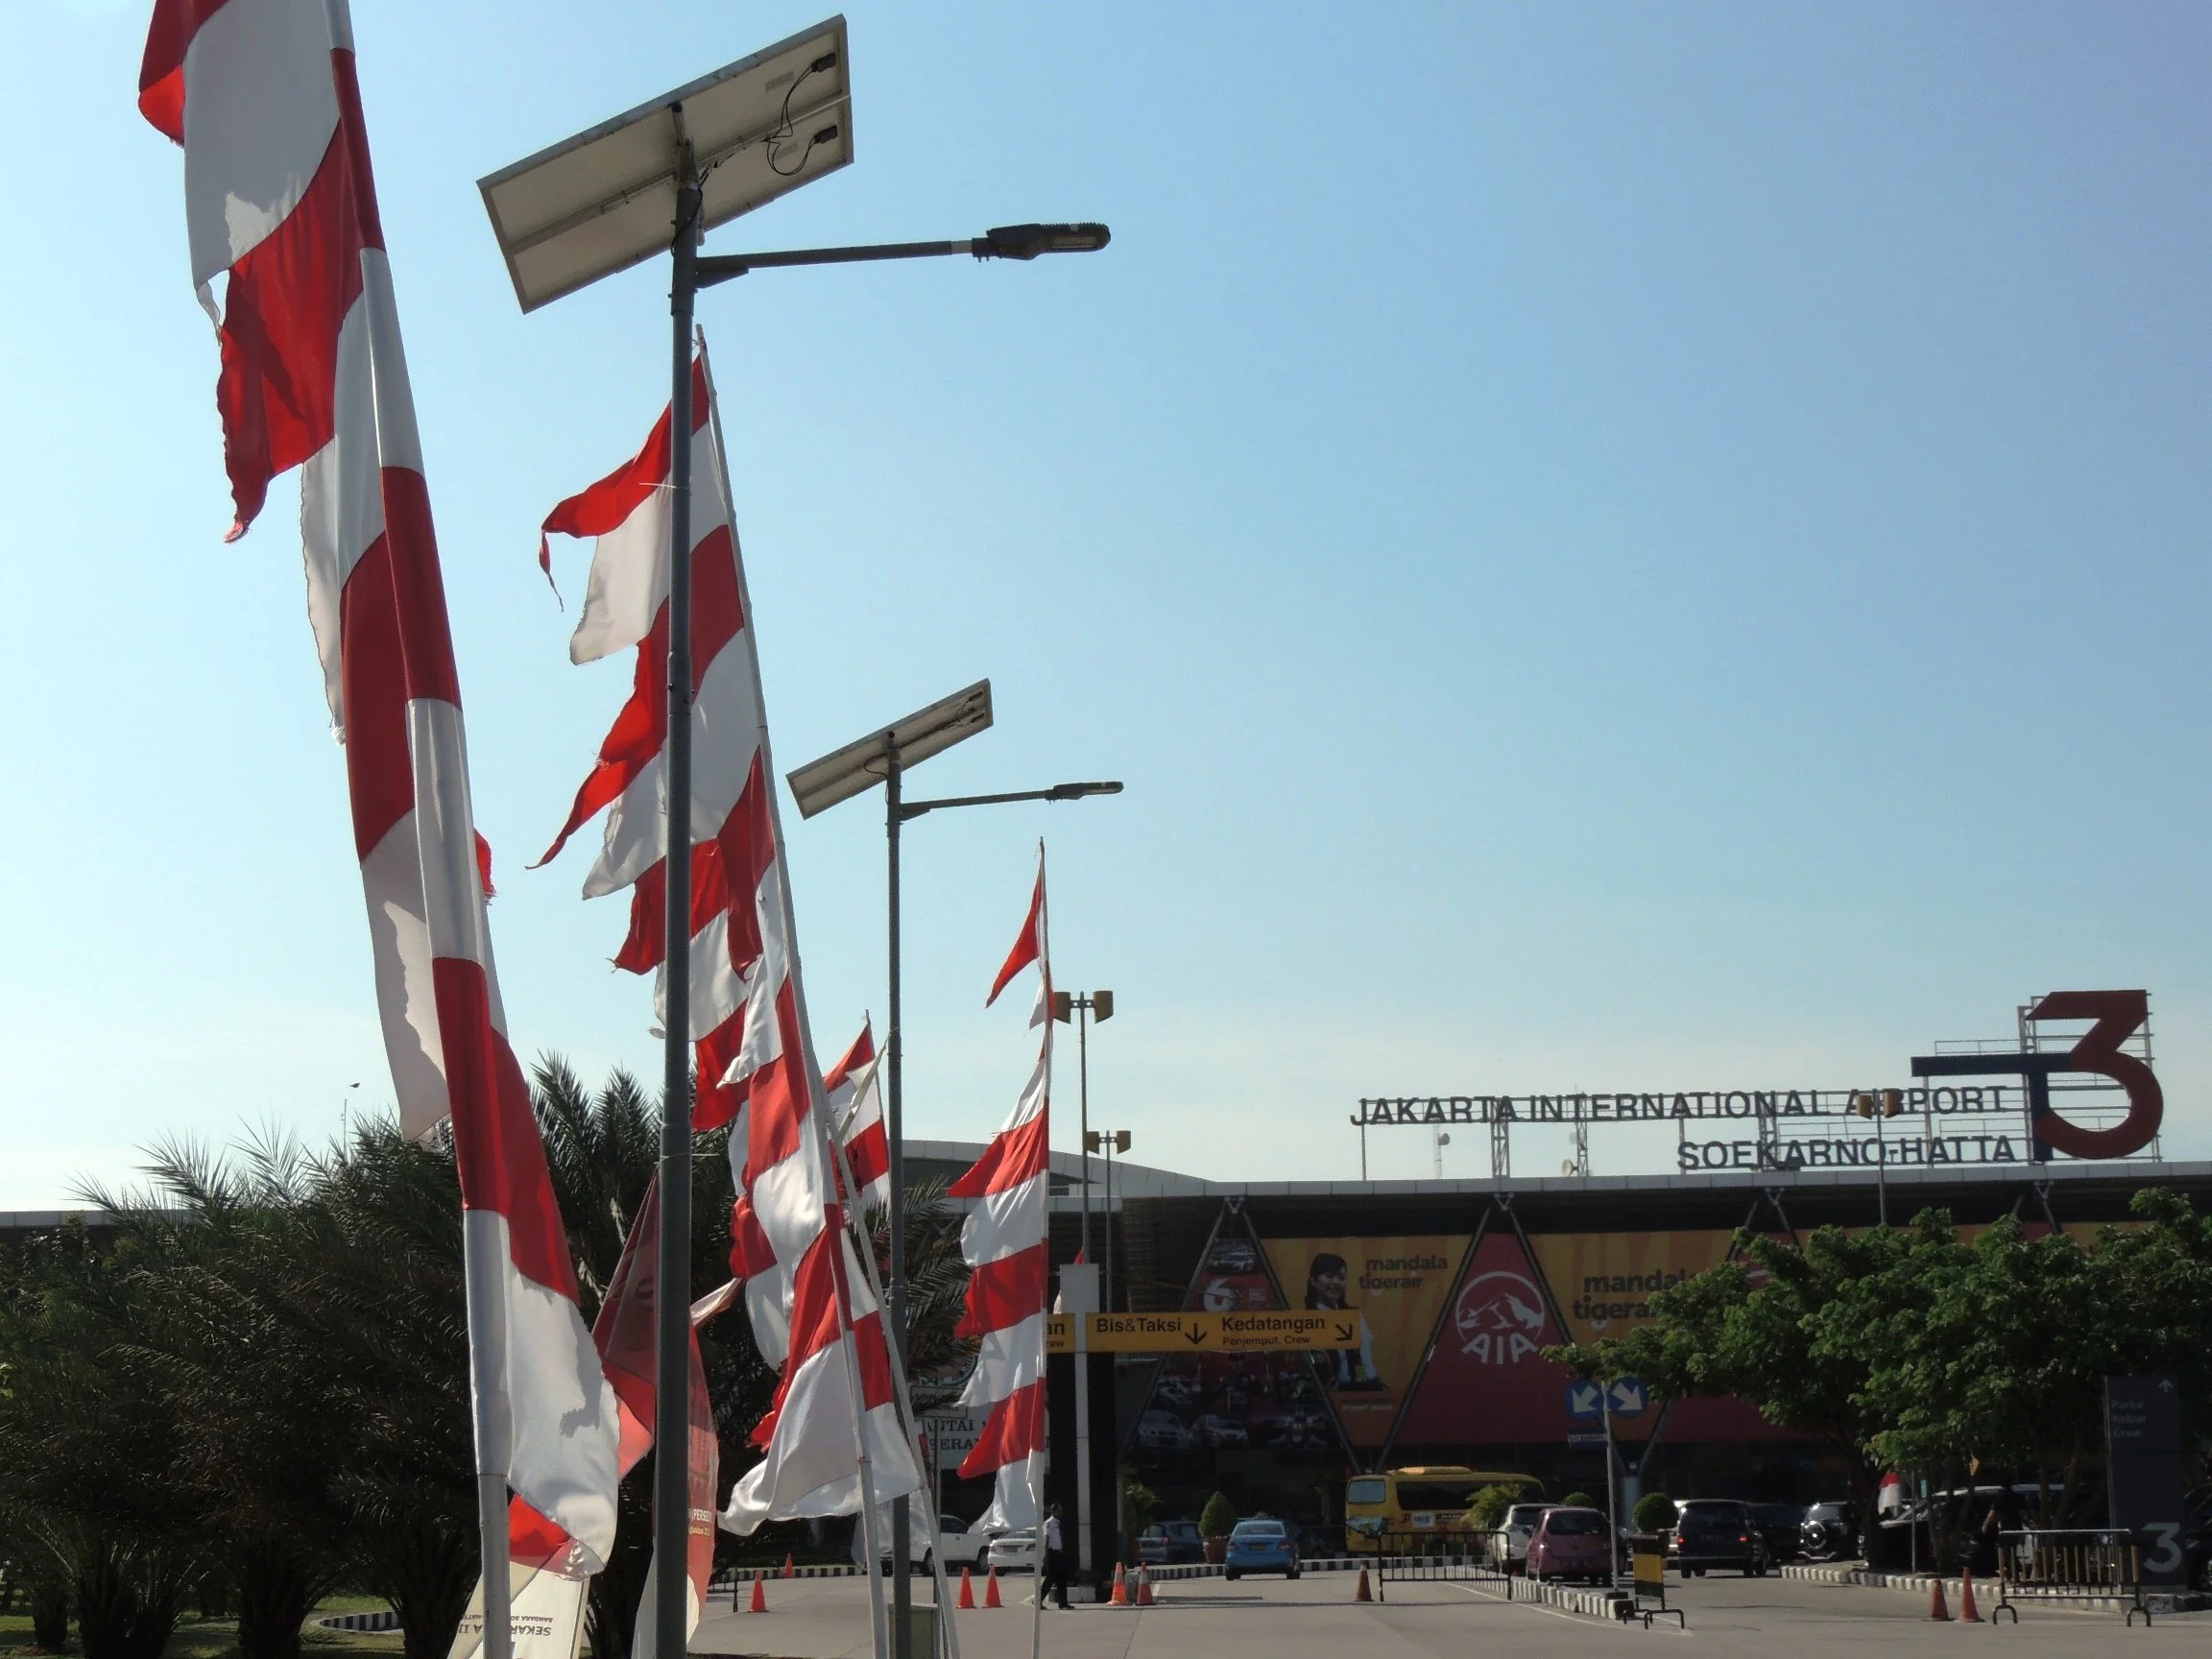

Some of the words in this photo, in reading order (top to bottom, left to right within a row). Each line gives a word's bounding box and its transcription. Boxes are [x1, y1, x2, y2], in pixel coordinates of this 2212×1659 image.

[1350, 1095, 1518, 1126] JAKARTA
[1530, 1090, 1830, 1122] INTERNATIONAL
[1677, 1135, 2017, 1170] SOEKARNO-HATTA
[1365, 1255, 1448, 1271] mandala
[1359, 1273, 1426, 1290] tigerair
[1583, 1267, 1696, 1293] mandal
[1574, 1294, 1660, 1321] tigera
[1096, 1317, 1182, 1333] Bis&Taksi
[1222, 1316, 1326, 1334] Kedatangan
[1284, 1334, 1310, 1345] Crew
[1461, 1332, 1538, 1365] AIA
[2112, 1427, 2143, 1438] Crew
[2141, 1522, 2183, 1574] 3
